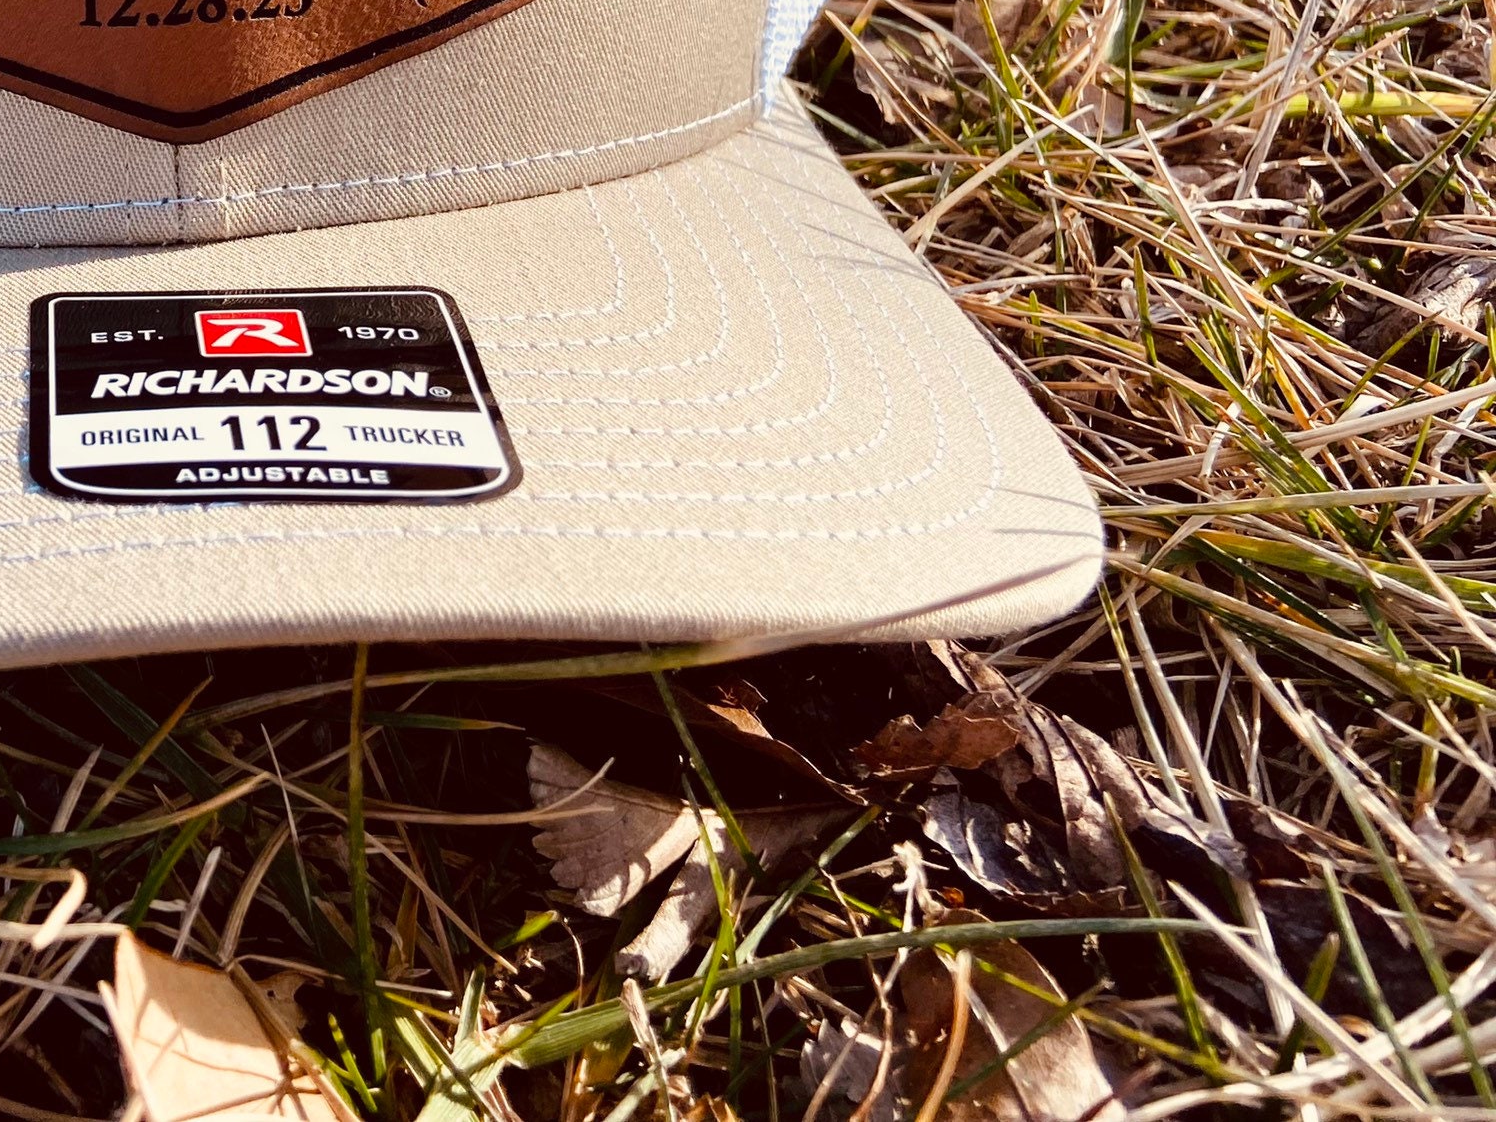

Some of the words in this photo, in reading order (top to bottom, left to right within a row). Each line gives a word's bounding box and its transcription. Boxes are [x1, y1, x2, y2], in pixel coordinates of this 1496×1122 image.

[90, 329, 164, 344] EST.
[337, 325, 420, 341] 1970
[81, 425, 204, 447] ORIGINAL
[220, 415, 327, 452] 112
[343, 424, 465, 447] TRUCKER
[175, 465, 390, 485] ADJUSTABLE
